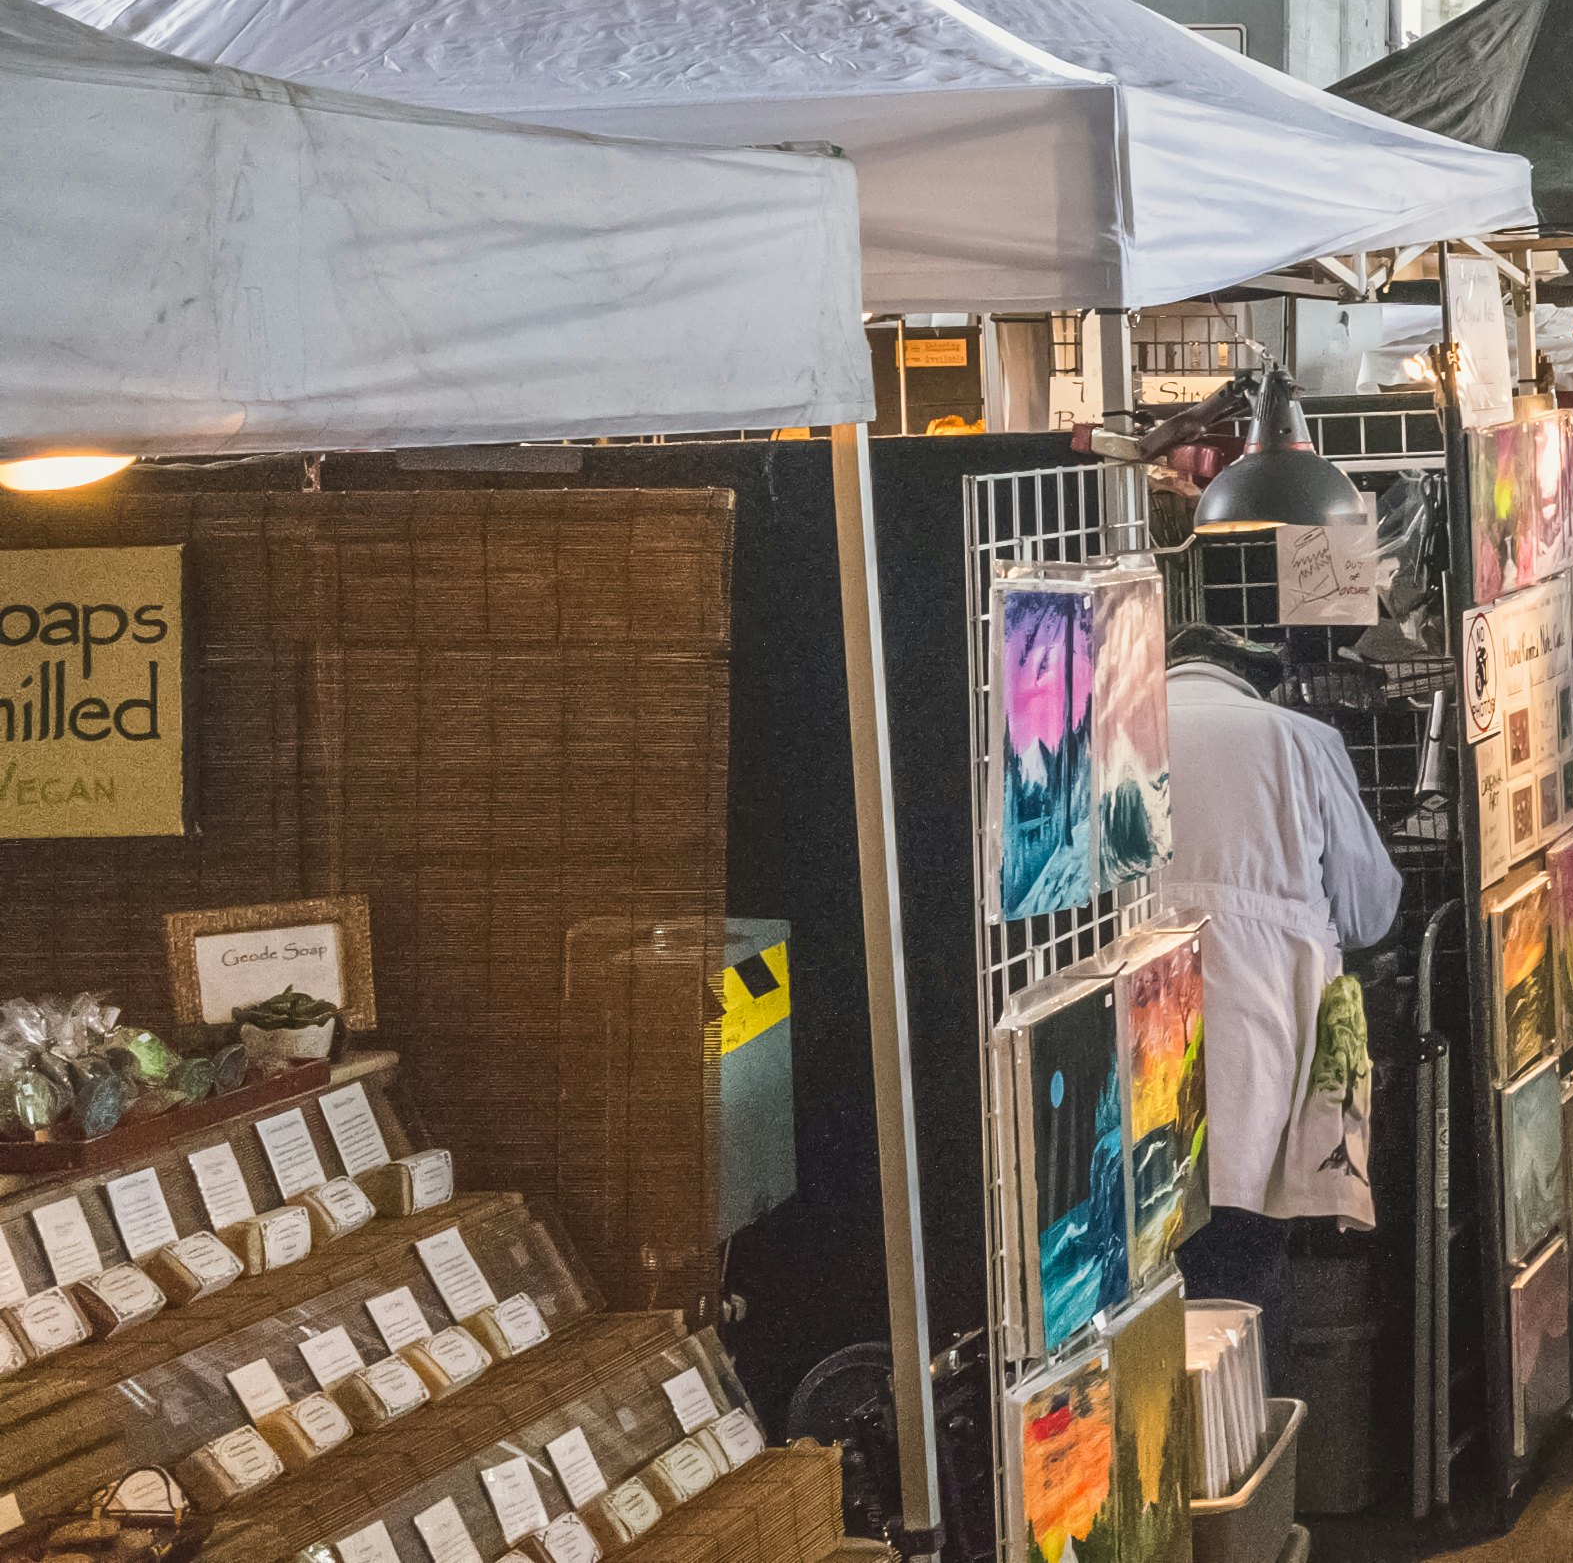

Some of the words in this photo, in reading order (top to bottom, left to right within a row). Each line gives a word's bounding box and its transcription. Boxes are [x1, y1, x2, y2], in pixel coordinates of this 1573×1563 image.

[1345, 560, 1364, 570] OUT
[0, 601, 168, 679] oaps
[221, 945, 278, 966] Geode
[282, 942, 328, 961] Soap
